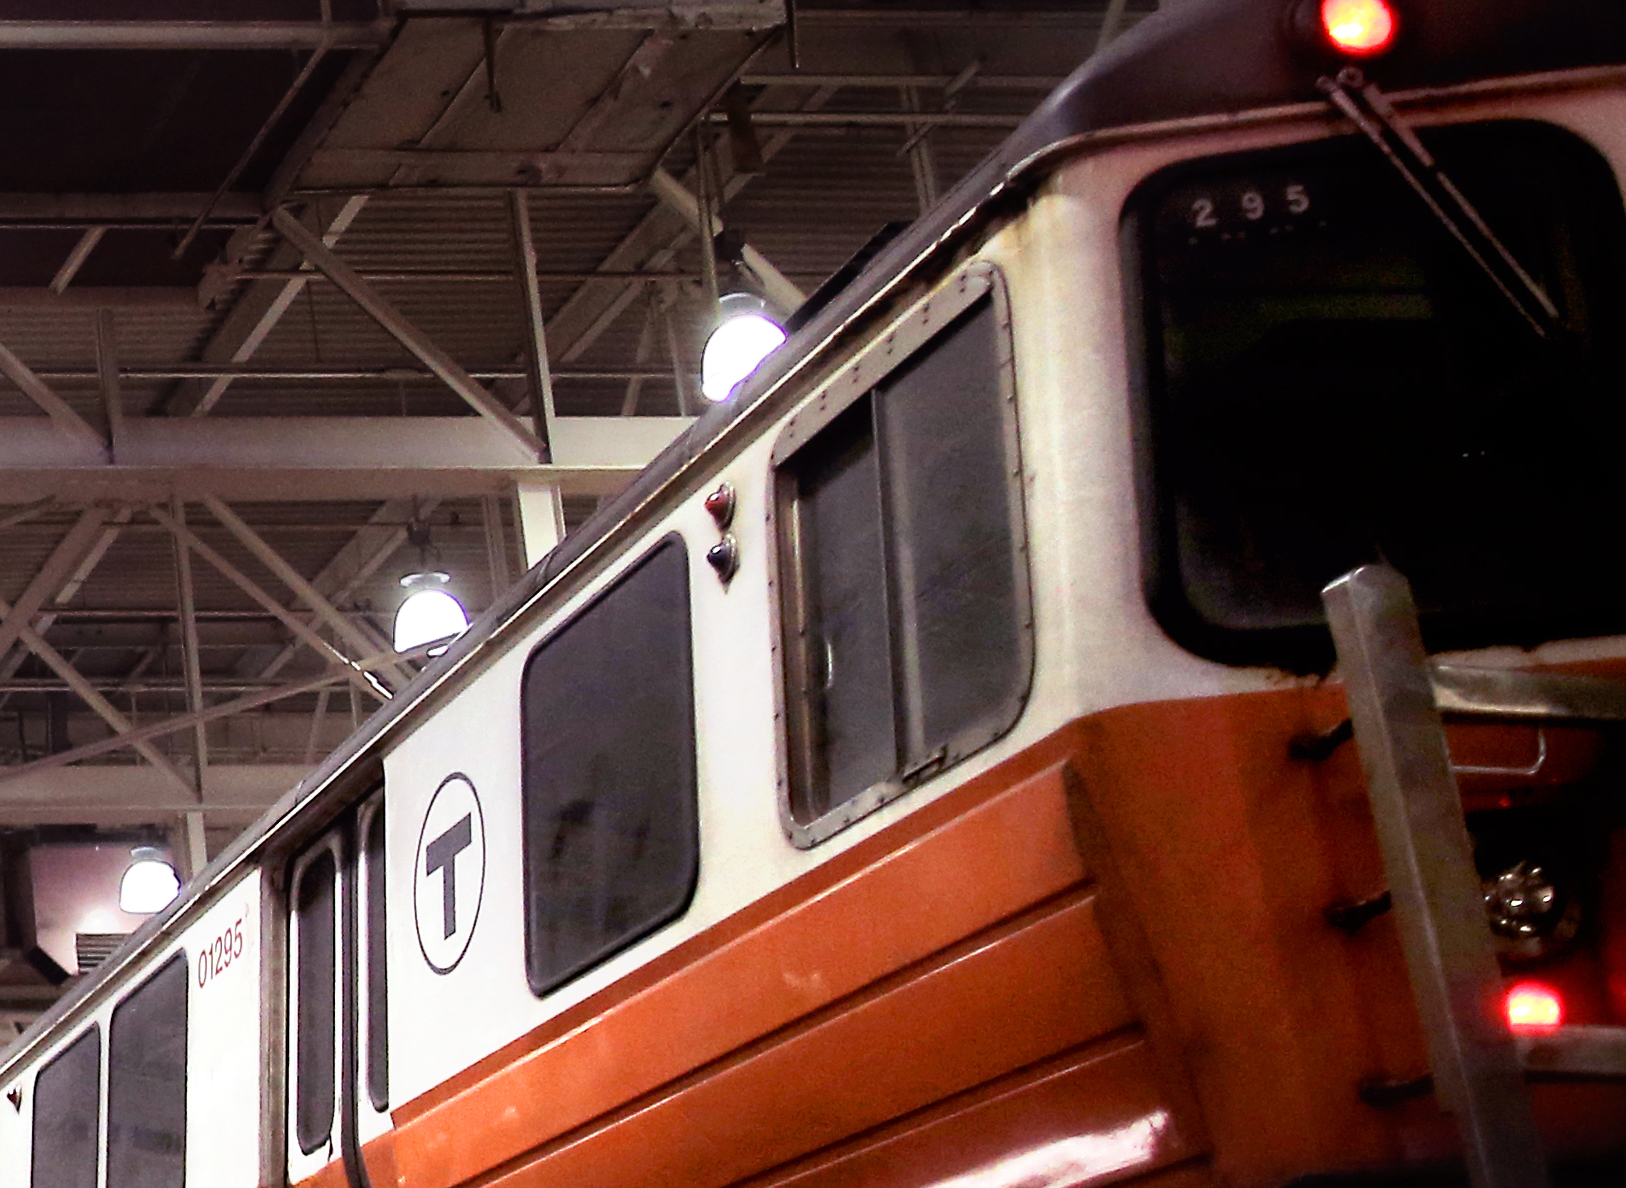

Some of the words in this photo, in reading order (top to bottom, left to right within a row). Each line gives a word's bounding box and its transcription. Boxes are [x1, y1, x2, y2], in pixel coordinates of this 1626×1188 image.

[1192, 184, 1310, 228] 295
[426, 811, 472, 940] T
[198, 917, 243, 989] 01295
